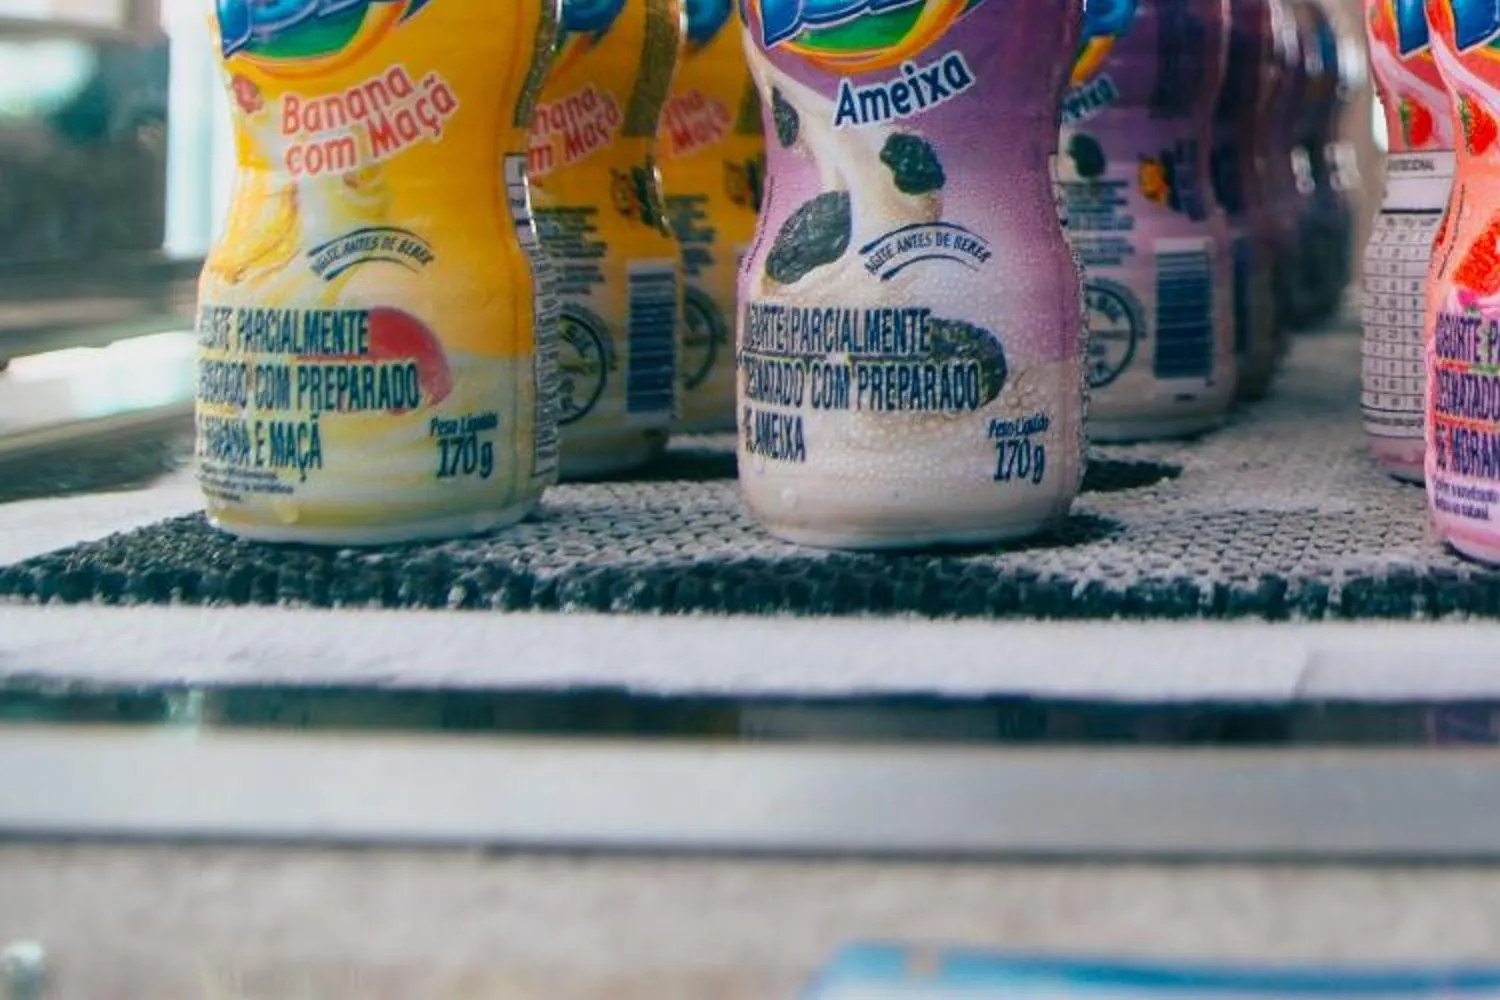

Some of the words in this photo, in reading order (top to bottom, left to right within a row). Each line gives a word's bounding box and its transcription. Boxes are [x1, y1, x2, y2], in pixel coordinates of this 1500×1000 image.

[281, 67, 414, 136] Banana
[834, 53, 976, 128] Ameixa
[285, 140, 357, 175] com
[370, 74, 456, 158] Maçã
[896, 231, 932, 254] ANTES
[935, 231, 951, 248] DE
[237, 307, 370, 356] PARCIALMENTE
[791, 306, 932, 353] PARCIALMENTE
[254, 364, 292, 411] COM
[297, 362, 420, 412] PREPARADO
[810, 362, 849, 410] COM
[856, 360, 982, 413] PREPARADO
[255, 419, 265, 468] E
[268, 413, 324, 483] MAÇÃ
[436, 432, 494, 480] 170g
[755, 408, 807, 463] AMEIXA
[993, 436, 1045, 486] 170g
